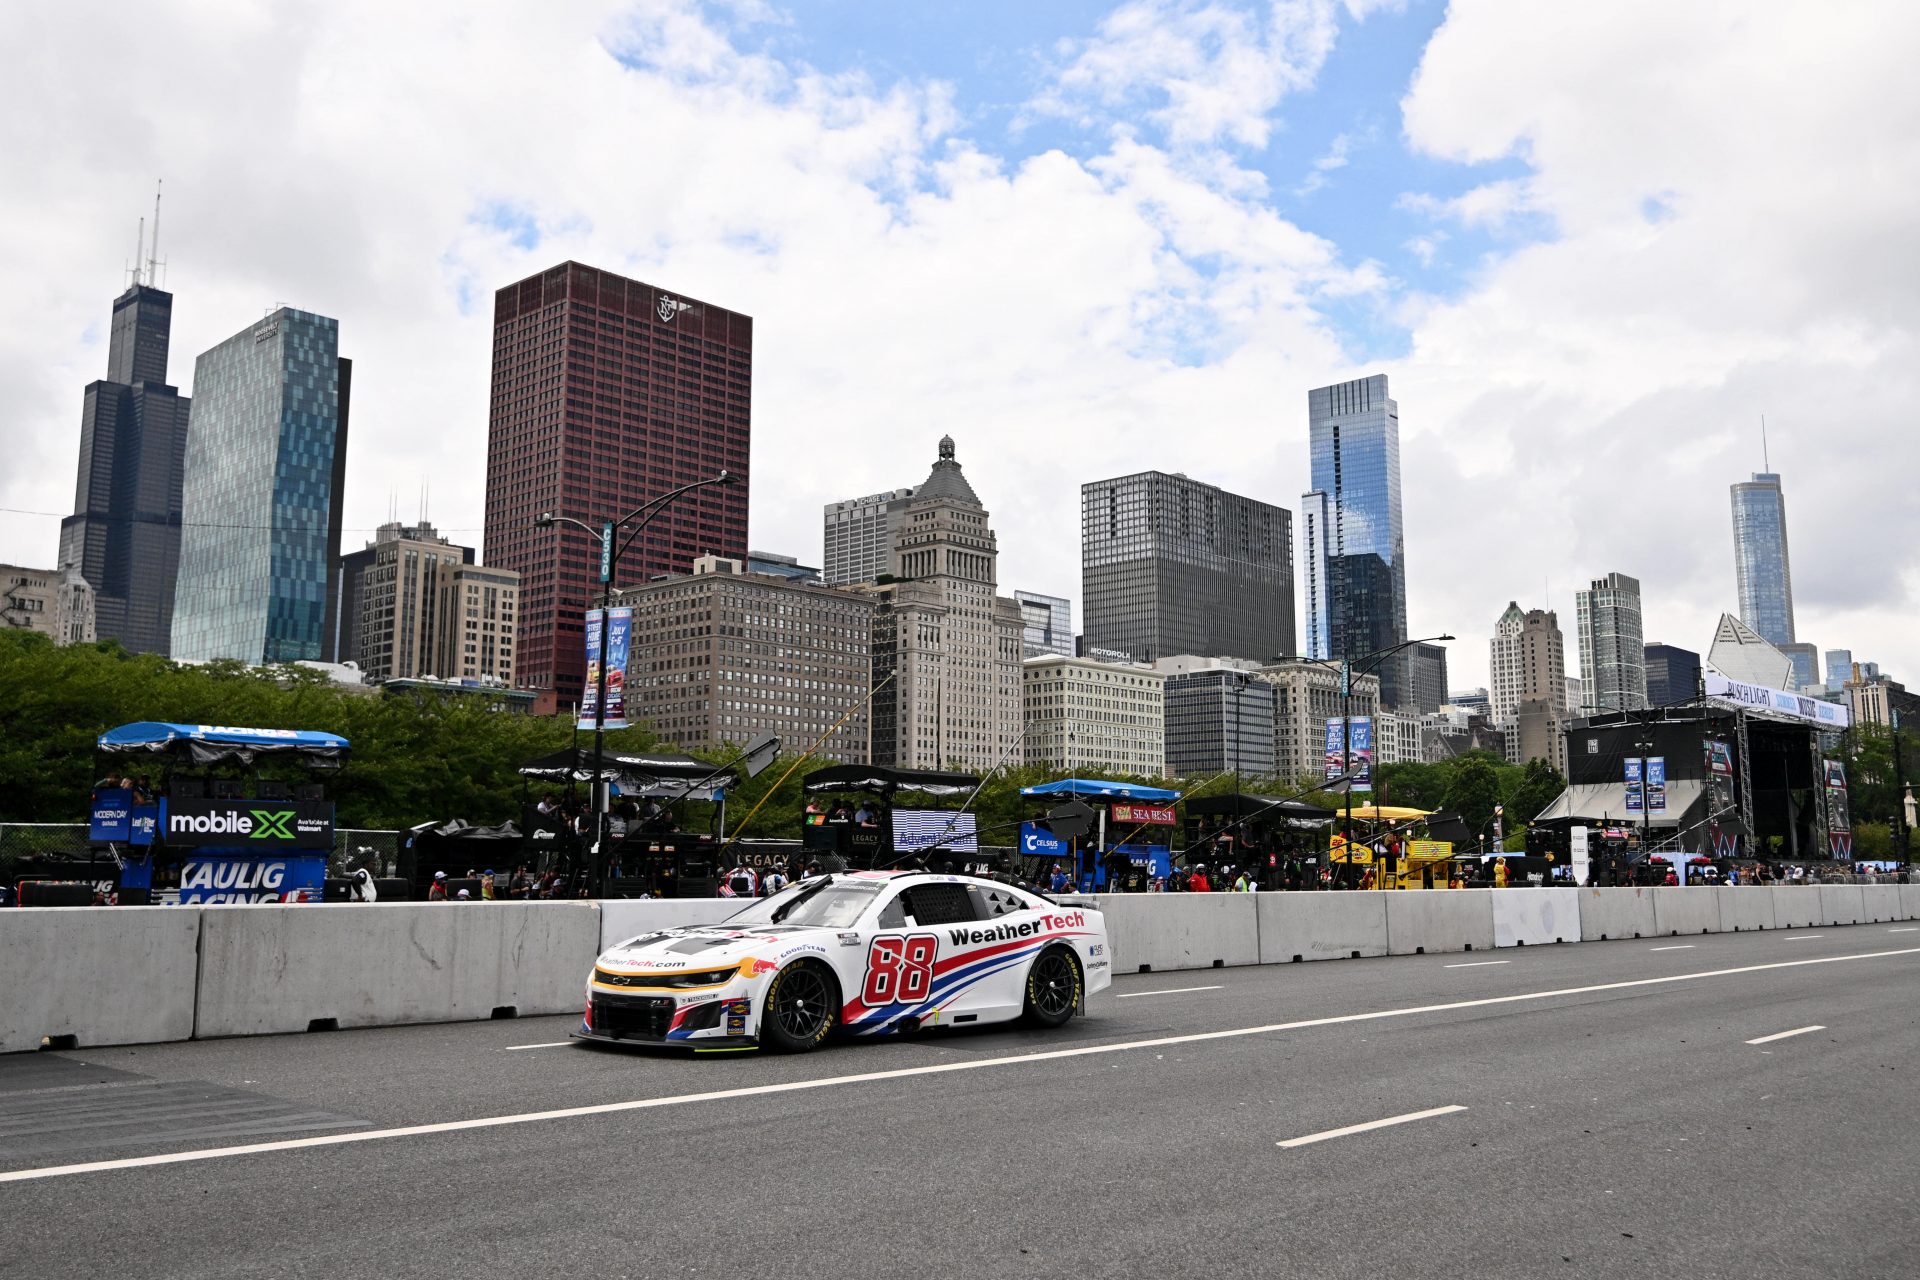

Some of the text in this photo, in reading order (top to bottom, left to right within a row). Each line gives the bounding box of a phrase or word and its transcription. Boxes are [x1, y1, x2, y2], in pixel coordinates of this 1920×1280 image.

[602, 528, 611, 576] C530
[612, 626, 626, 635] JULY
[1727, 681, 1749, 703] BUSCH
[1749, 685, 1771, 707] LIGHT
[1797, 697, 1816, 719] MUSIC
[94, 810, 128, 818] MODERN DAY
[1133, 808, 1150, 819] SEA
[852, 834, 878, 842] LEGACY
[737, 854, 790, 866] LEGACY
[181, 862, 286, 890] KAULIG
[949, 911, 1085, 947] WeatherTech
[780, 943, 826, 958] GOODYEAR
[860, 932, 940, 1008] 88
[1064, 953, 1080, 1009] GOODYEAR
[767, 960, 804, 1011] GOODYEAR
[1028, 975, 1037, 1006] EAGLE
[815, 1014, 834, 1042] EAGLE
